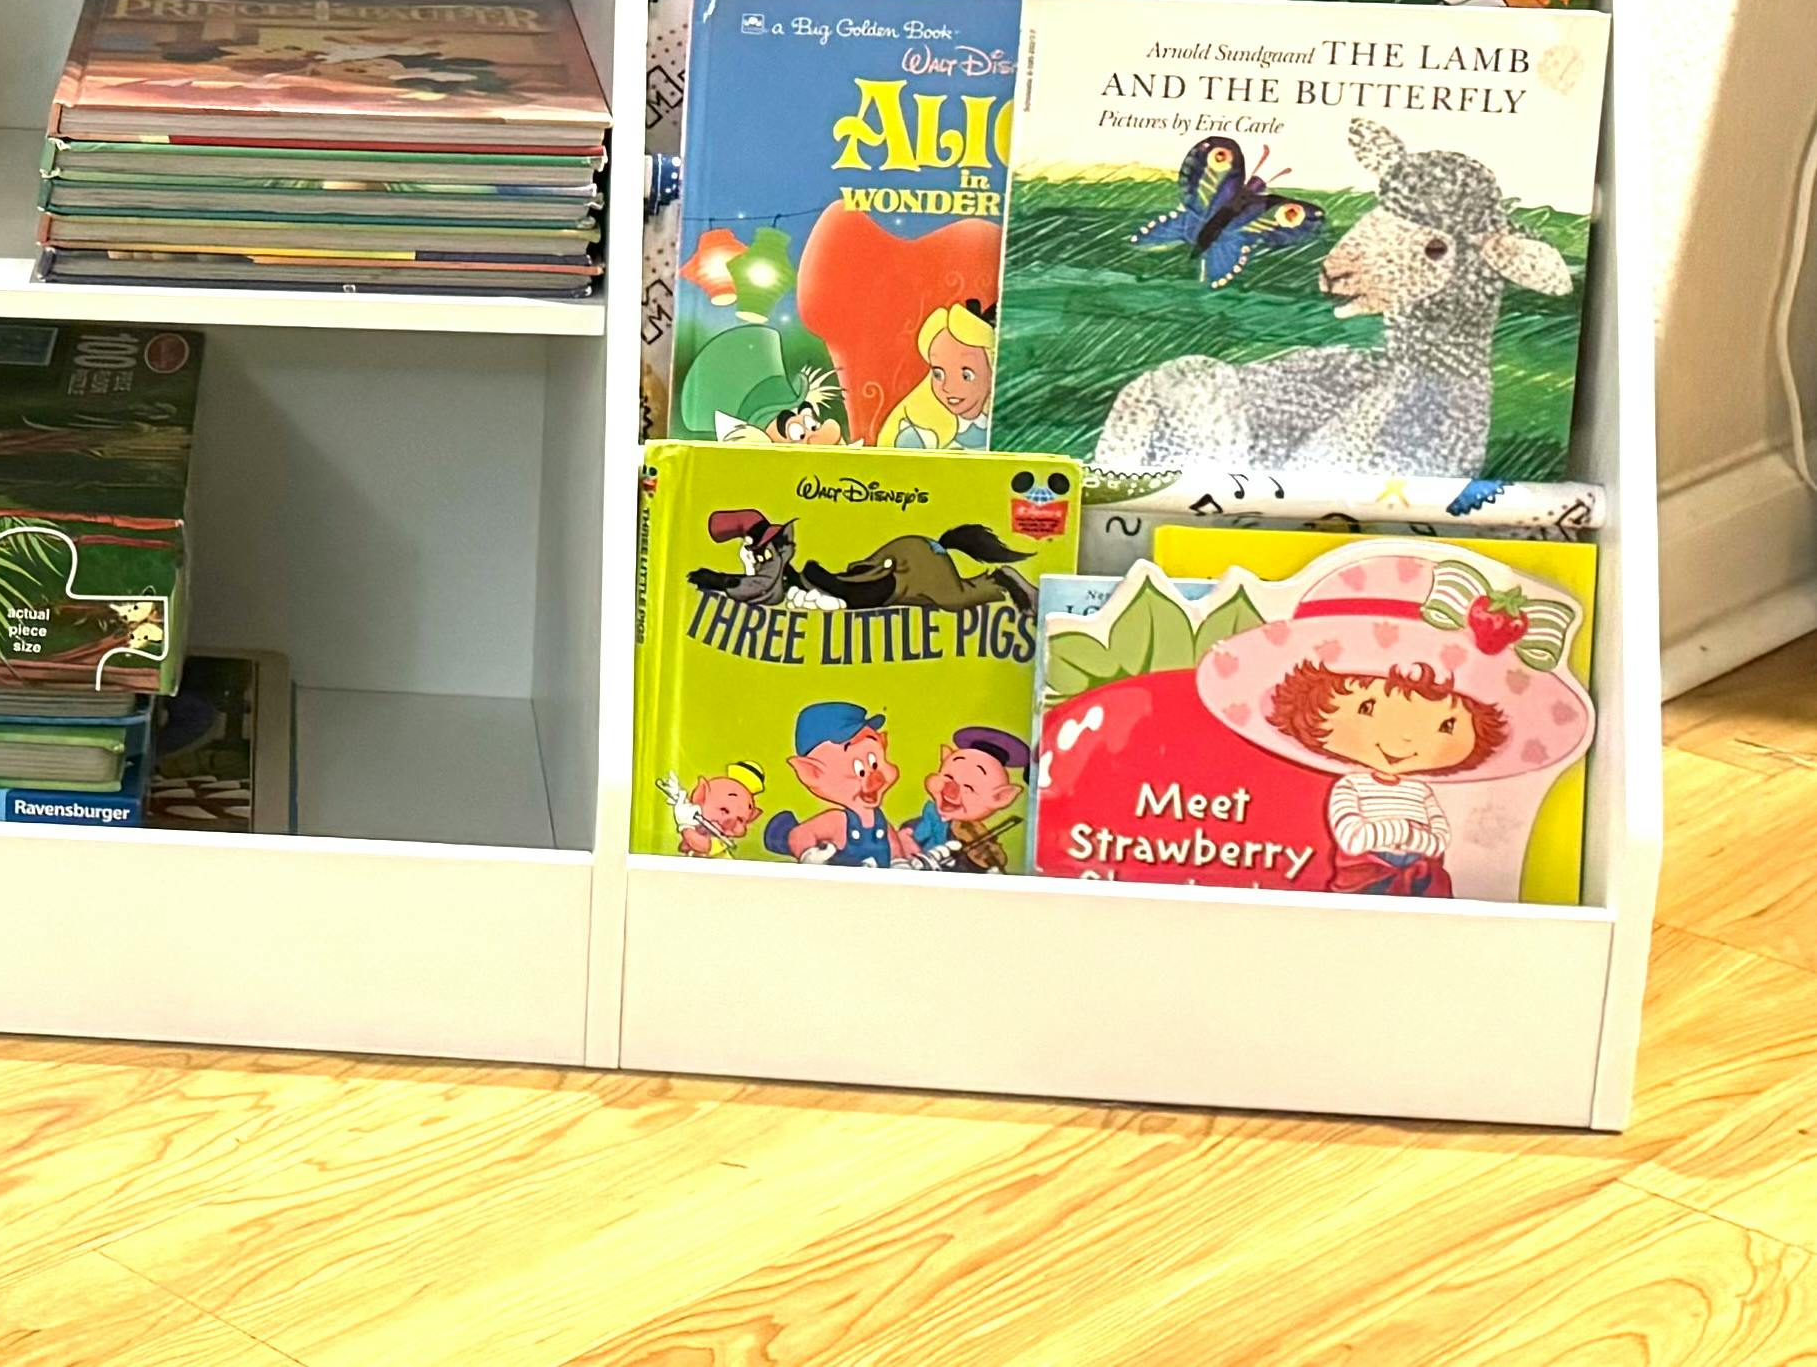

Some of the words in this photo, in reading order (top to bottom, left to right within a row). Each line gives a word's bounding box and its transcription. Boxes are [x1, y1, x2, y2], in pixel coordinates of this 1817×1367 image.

[772, 23, 785, 34] a
[791, 17, 832, 45] Big
[836, 18, 899, 38] Golden
[903, 20, 953, 40] Book
[1146, 41, 1211, 61] Arnold
[1215, 44, 1317, 69] Sundgaard
[1322, 40, 1405, 68] THE
[1418, 44, 1530, 74] LAMB
[1101, 72, 1186, 100] AND
[1198, 75, 1281, 104] THE
[1295, 80, 1528, 114] BUTTERFLY
[1098, 109, 1169, 130] Pictures
[1172, 112, 1192, 136] by
[1195, 113, 1233, 132] Eric
[1235, 115, 1285, 134] Carle
[960, 169, 990, 189] in
[7, 608, 50, 621] actual
[686, 589, 808, 665] THREE
[820, 606, 943, 666] LITTLE
[955, 604, 1036, 664] PIGS
[8, 623, 48, 638] piece
[13, 641, 42, 653] size
[14, 799, 131, 823] Ravensburger
[1135, 782, 1252, 823] Meet
[1067, 823, 1314, 880] Strawberry
